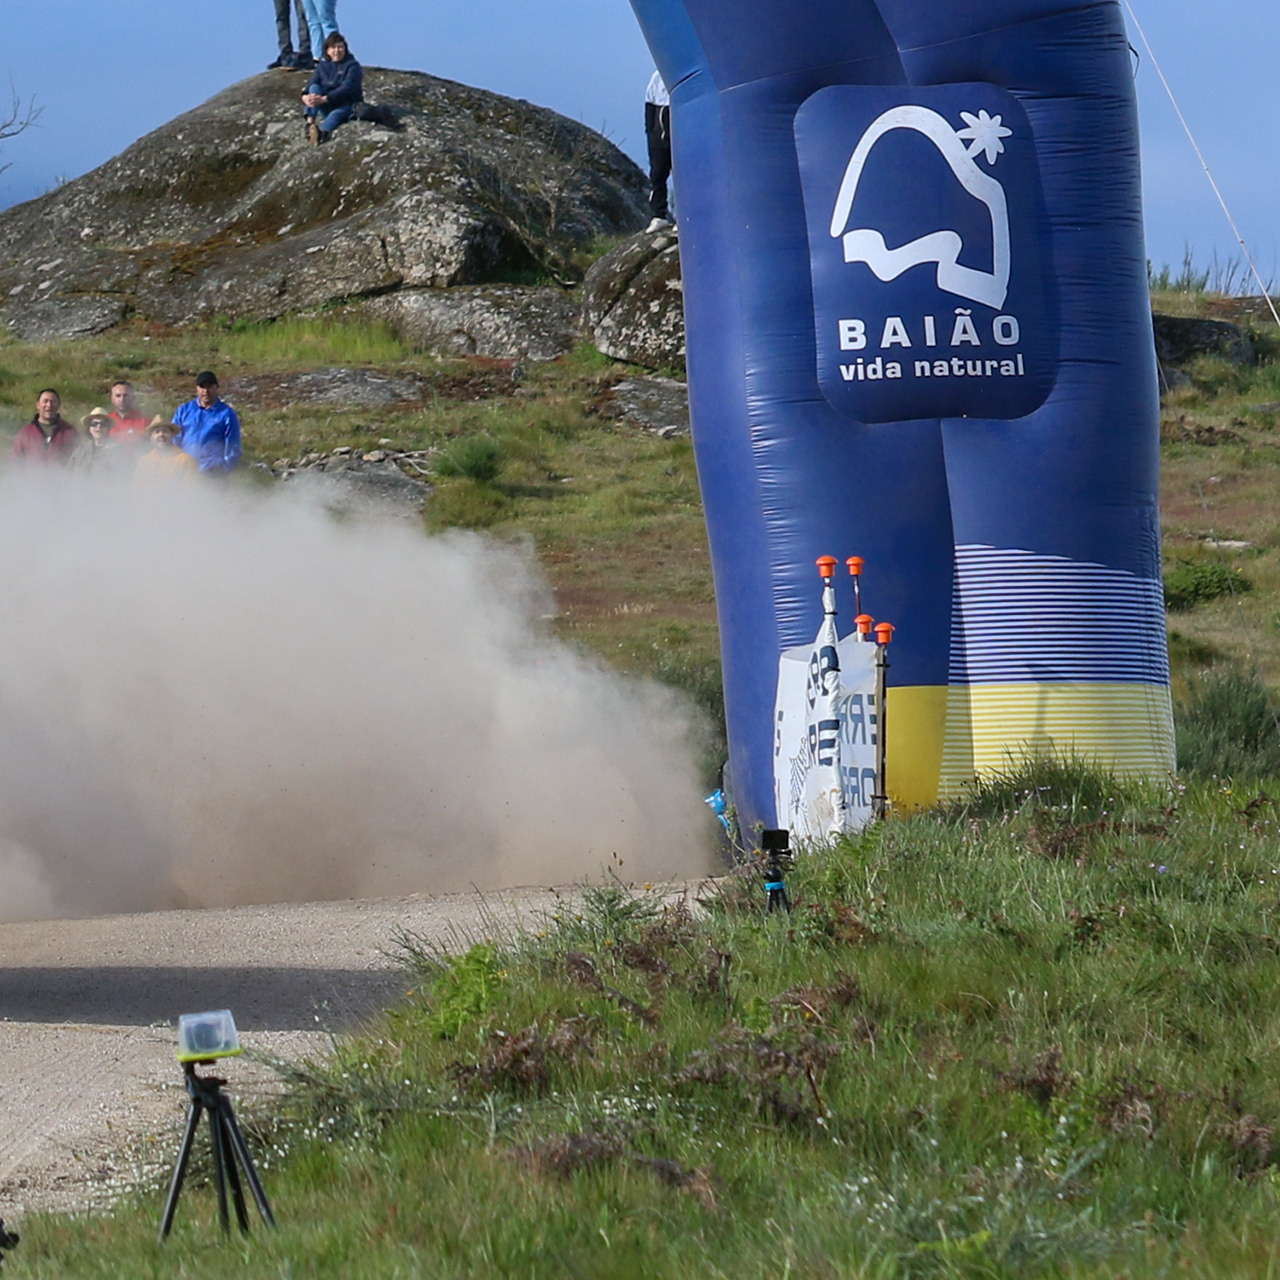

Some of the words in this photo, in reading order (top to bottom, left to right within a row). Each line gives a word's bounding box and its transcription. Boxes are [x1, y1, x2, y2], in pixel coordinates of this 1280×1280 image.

[838, 307, 1020, 351] BAIÃO
[840, 357, 902, 382] vida
[914, 353, 1025, 378] natural
